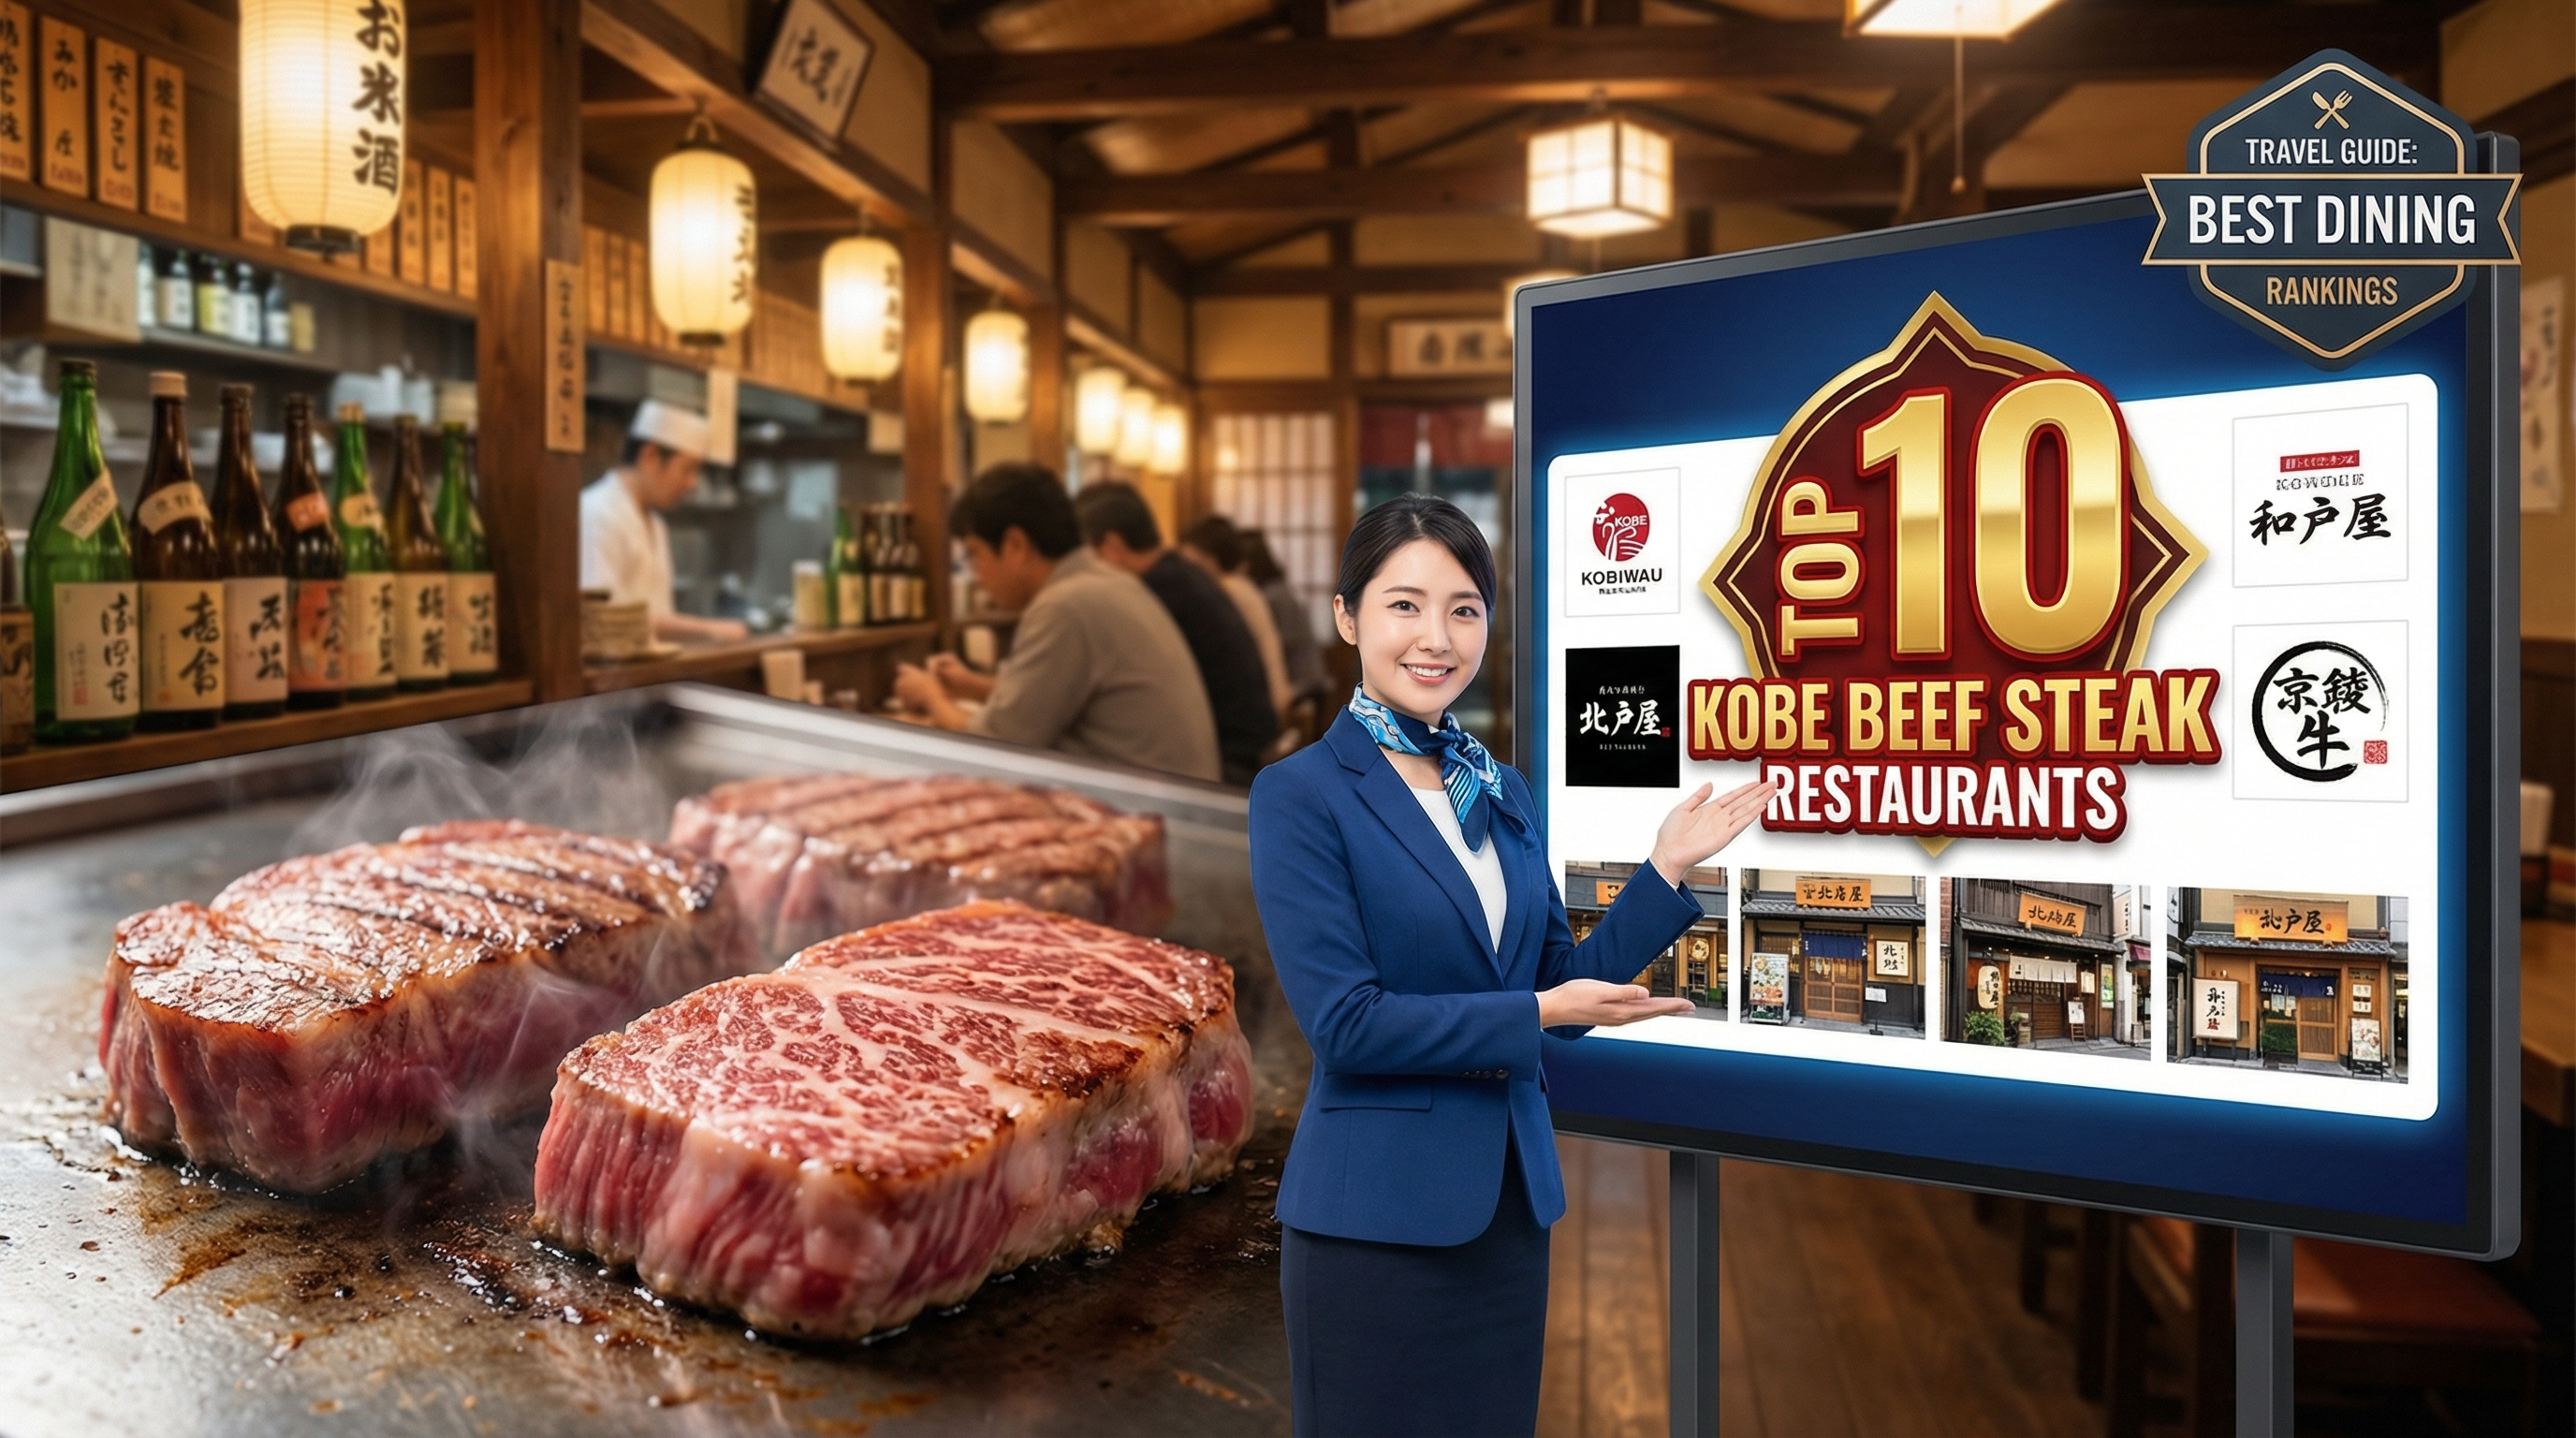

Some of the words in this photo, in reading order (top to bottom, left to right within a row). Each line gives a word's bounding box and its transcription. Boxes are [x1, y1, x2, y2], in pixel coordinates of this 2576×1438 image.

[1615, 515, 1647, 527] KOBE
[1863, 378, 2121, 653] 10
[1581, 567, 1662, 586] KOBIWAU
[1780, 481, 1860, 656] TOP
[1693, 683, 1829, 751] KOBE
[1849, 680, 1984, 752] BEEF
[2005, 676, 2212, 753] STEAK
[1766, 764, 2118, 829] RESTAURANTS
